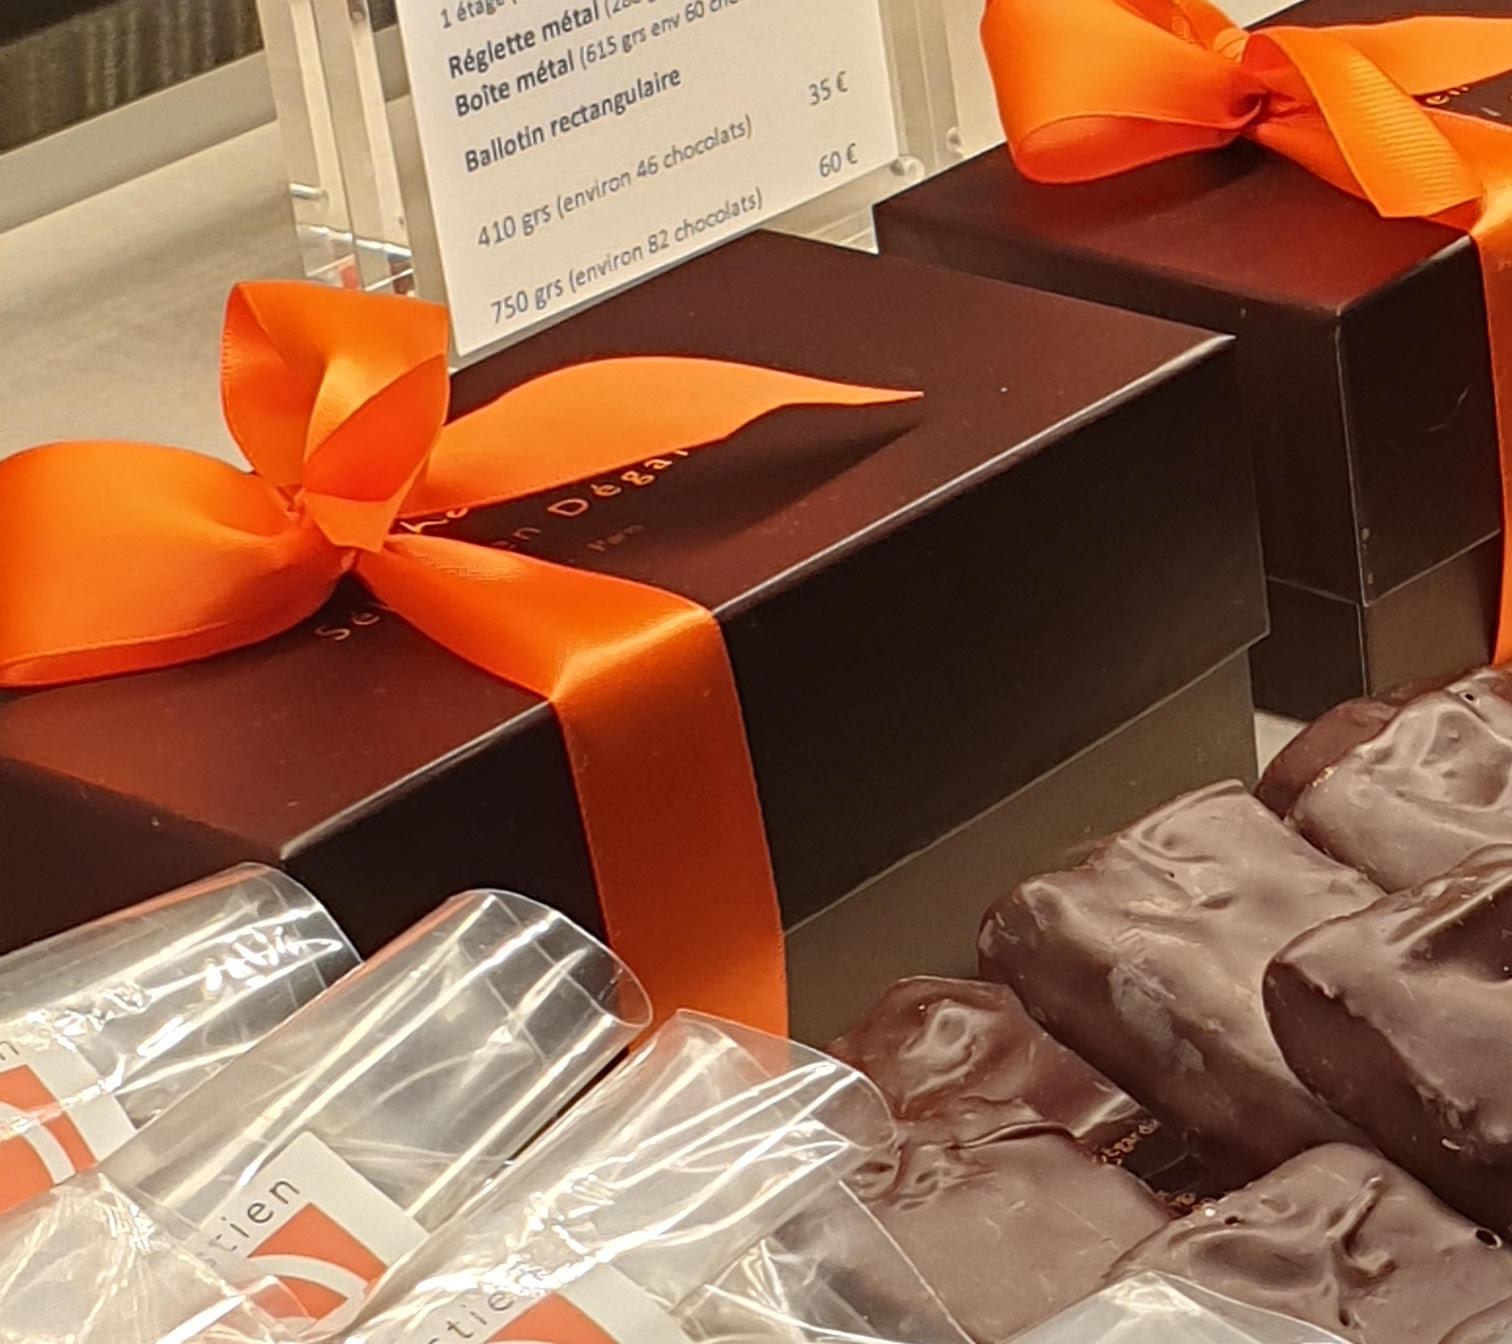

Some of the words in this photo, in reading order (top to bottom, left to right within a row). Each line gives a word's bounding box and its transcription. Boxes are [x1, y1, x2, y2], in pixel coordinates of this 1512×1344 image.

[439, 7, 453, 29] 1
[447, 29, 536, 79] Réglette
[454, 80, 511, 118] Boîte
[515, 48, 575, 93] métal
[578, 34, 618, 71] (615
[620, 26, 647, 54] grs
[649, 12, 681, 37] env
[463, 124, 545, 173] Ballotin
[549, 68, 682, 138] rectangulaire
[477, 214, 517, 247] 410
[520, 203, 552, 237] grs
[555, 170, 632, 220] (environ
[635, 153, 659, 178] 46
[661, 112, 752, 169] chocolats)
[807, 76, 832, 106] 35
[834, 69, 849, 93] €
[489, 288, 529, 324] 750
[533, 277, 564, 310] grs
[567, 244, 644, 294] (environ
[646, 227, 670, 255] 82
[673, 185, 763, 243] chocolats)
[818, 149, 842, 178] 60
[844, 141, 858, 165] €
